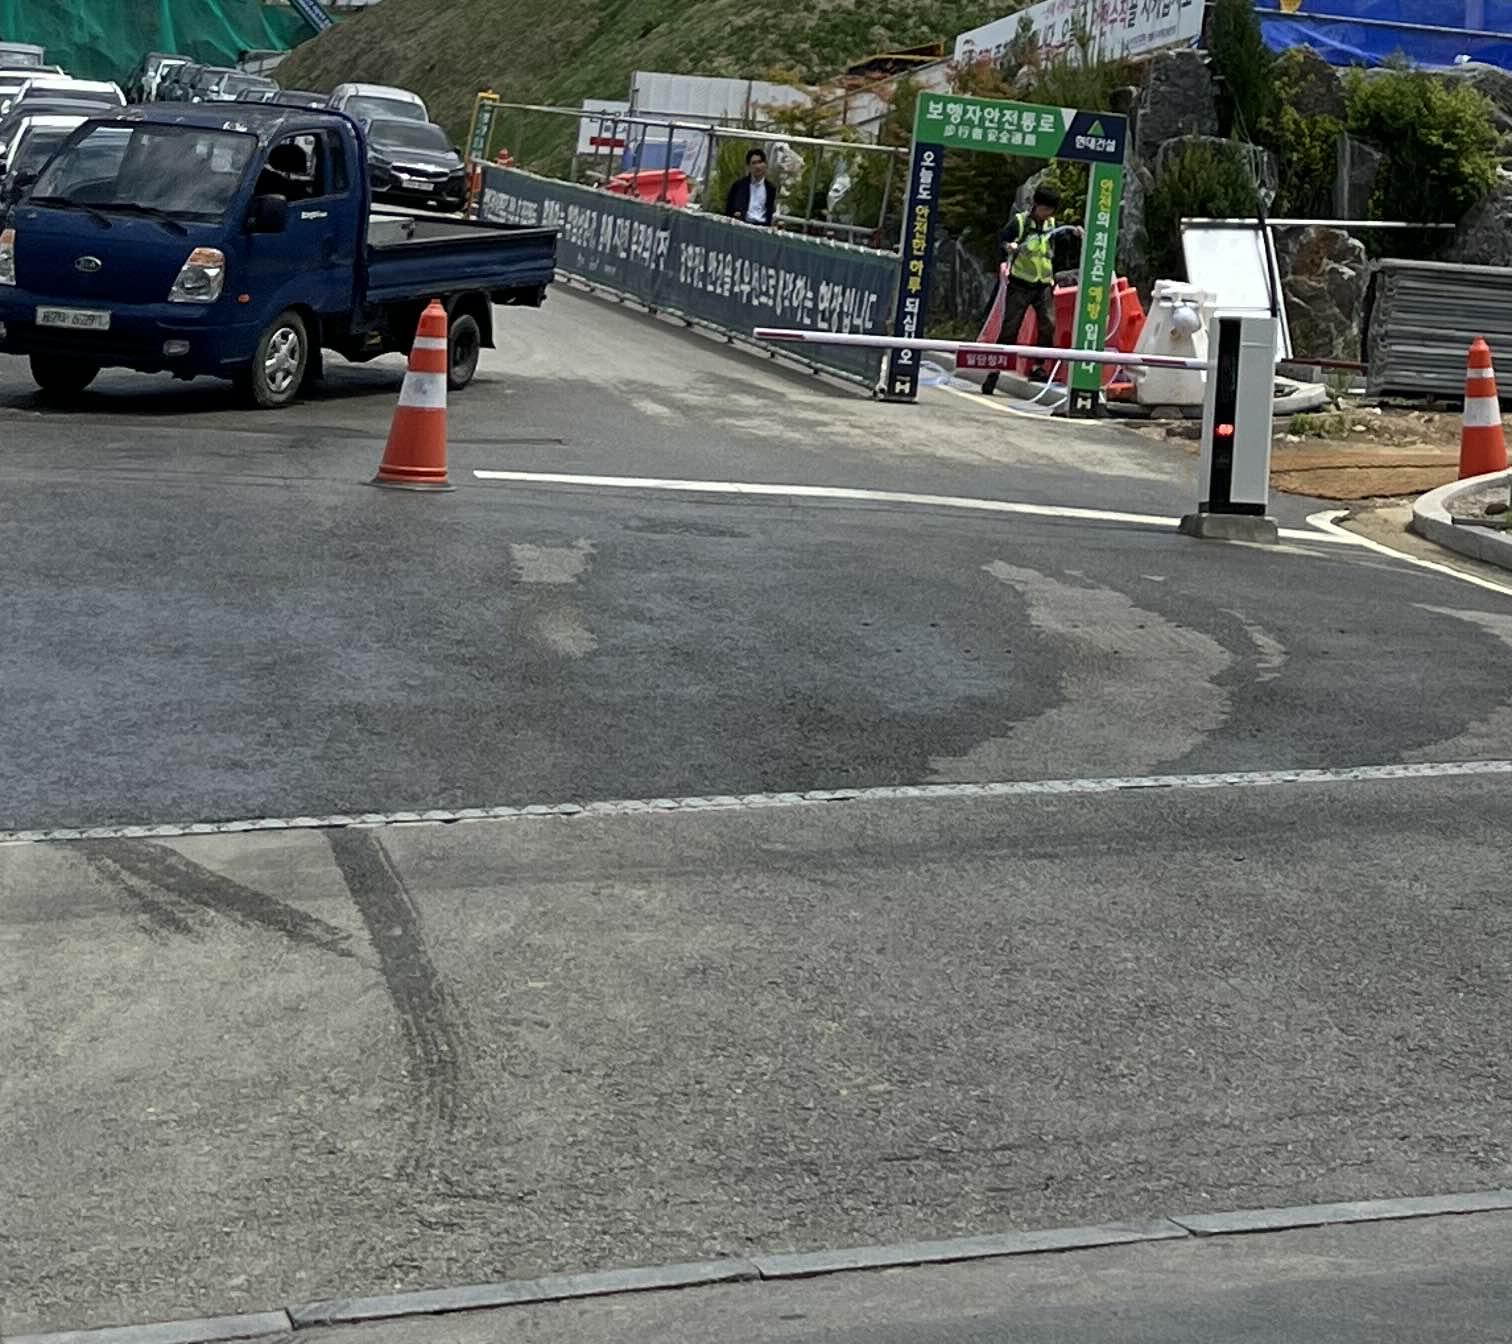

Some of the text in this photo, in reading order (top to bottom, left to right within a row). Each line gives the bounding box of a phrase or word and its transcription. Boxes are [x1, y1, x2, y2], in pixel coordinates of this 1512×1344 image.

[926, 100, 1056, 133] 보행자안전통로
[1075, 135, 1117, 153] 현대건설
[915, 150, 935, 200] 오늘도
[911, 204, 930, 256] 안전한
[908, 259, 926, 294] 하루
